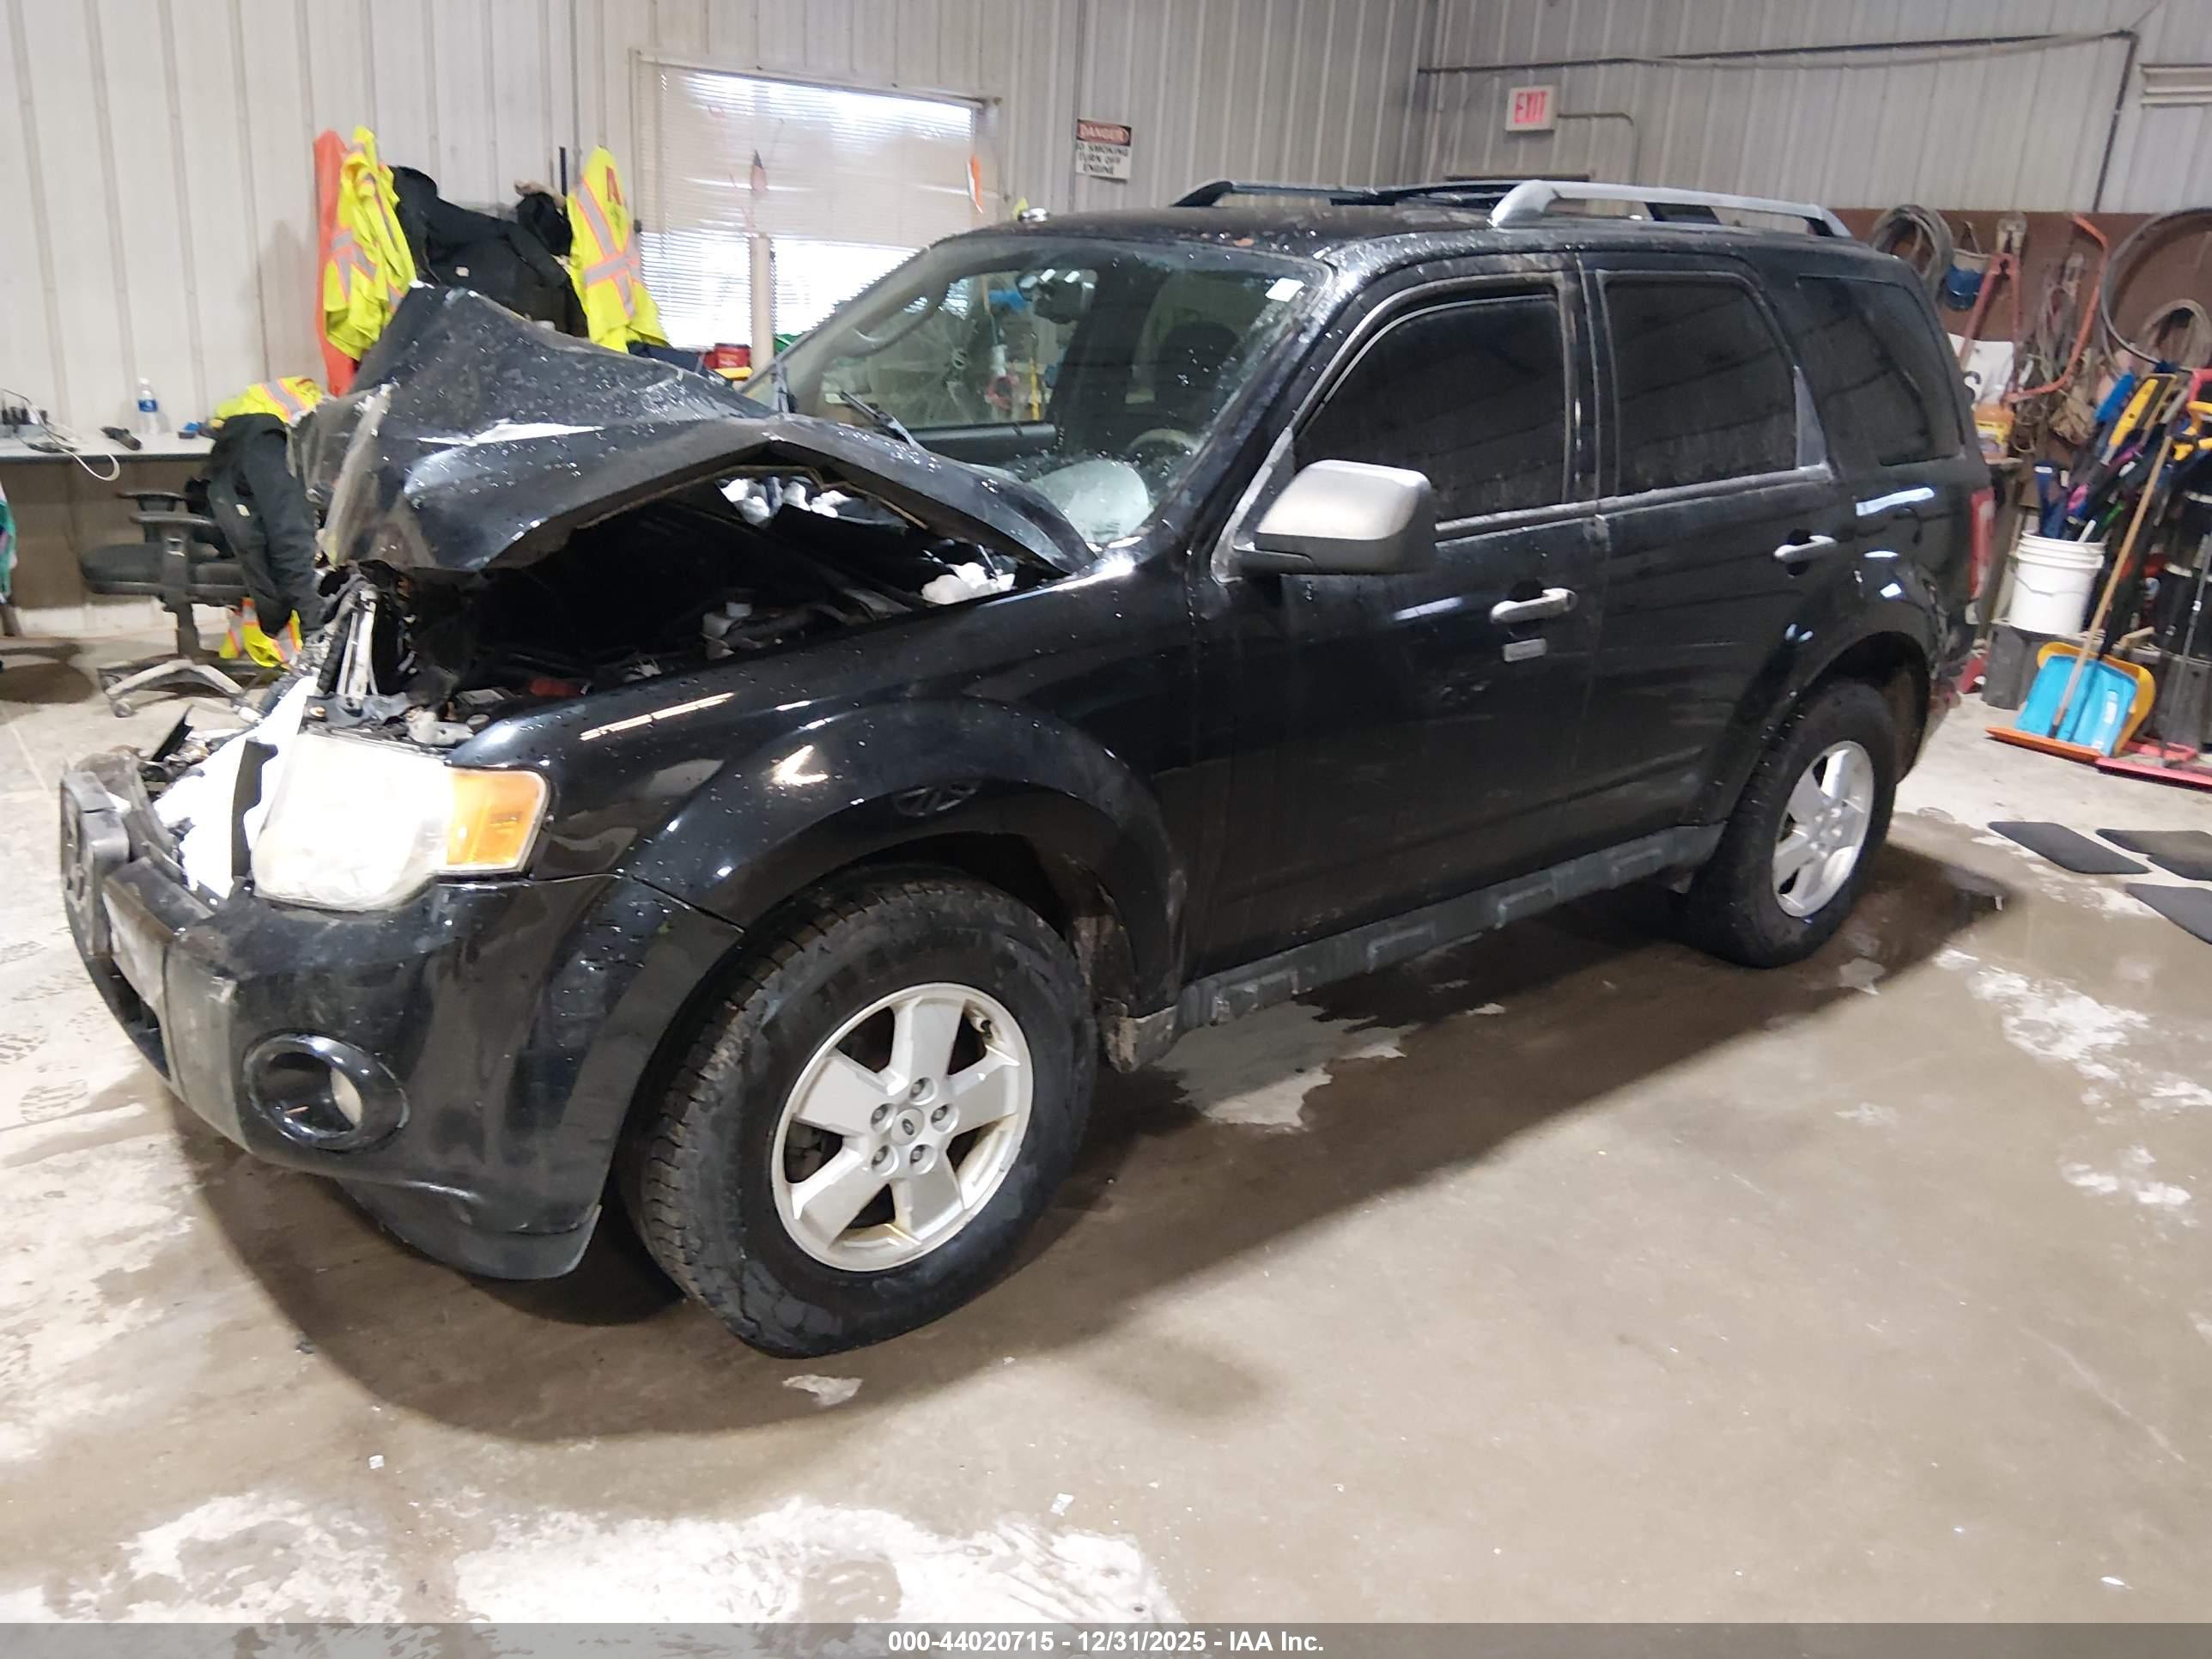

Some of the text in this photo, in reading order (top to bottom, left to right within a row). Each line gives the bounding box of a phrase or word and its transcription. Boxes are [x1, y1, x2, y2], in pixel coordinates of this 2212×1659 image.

[1514, 90, 1547, 124] EXIT
[1079, 123, 1124, 141] DANGER
[1087, 143, 1129, 156] SMOKING
[1079, 152, 1121, 165] TURN OFF
[1083, 163, 1114, 174] ENGINE
